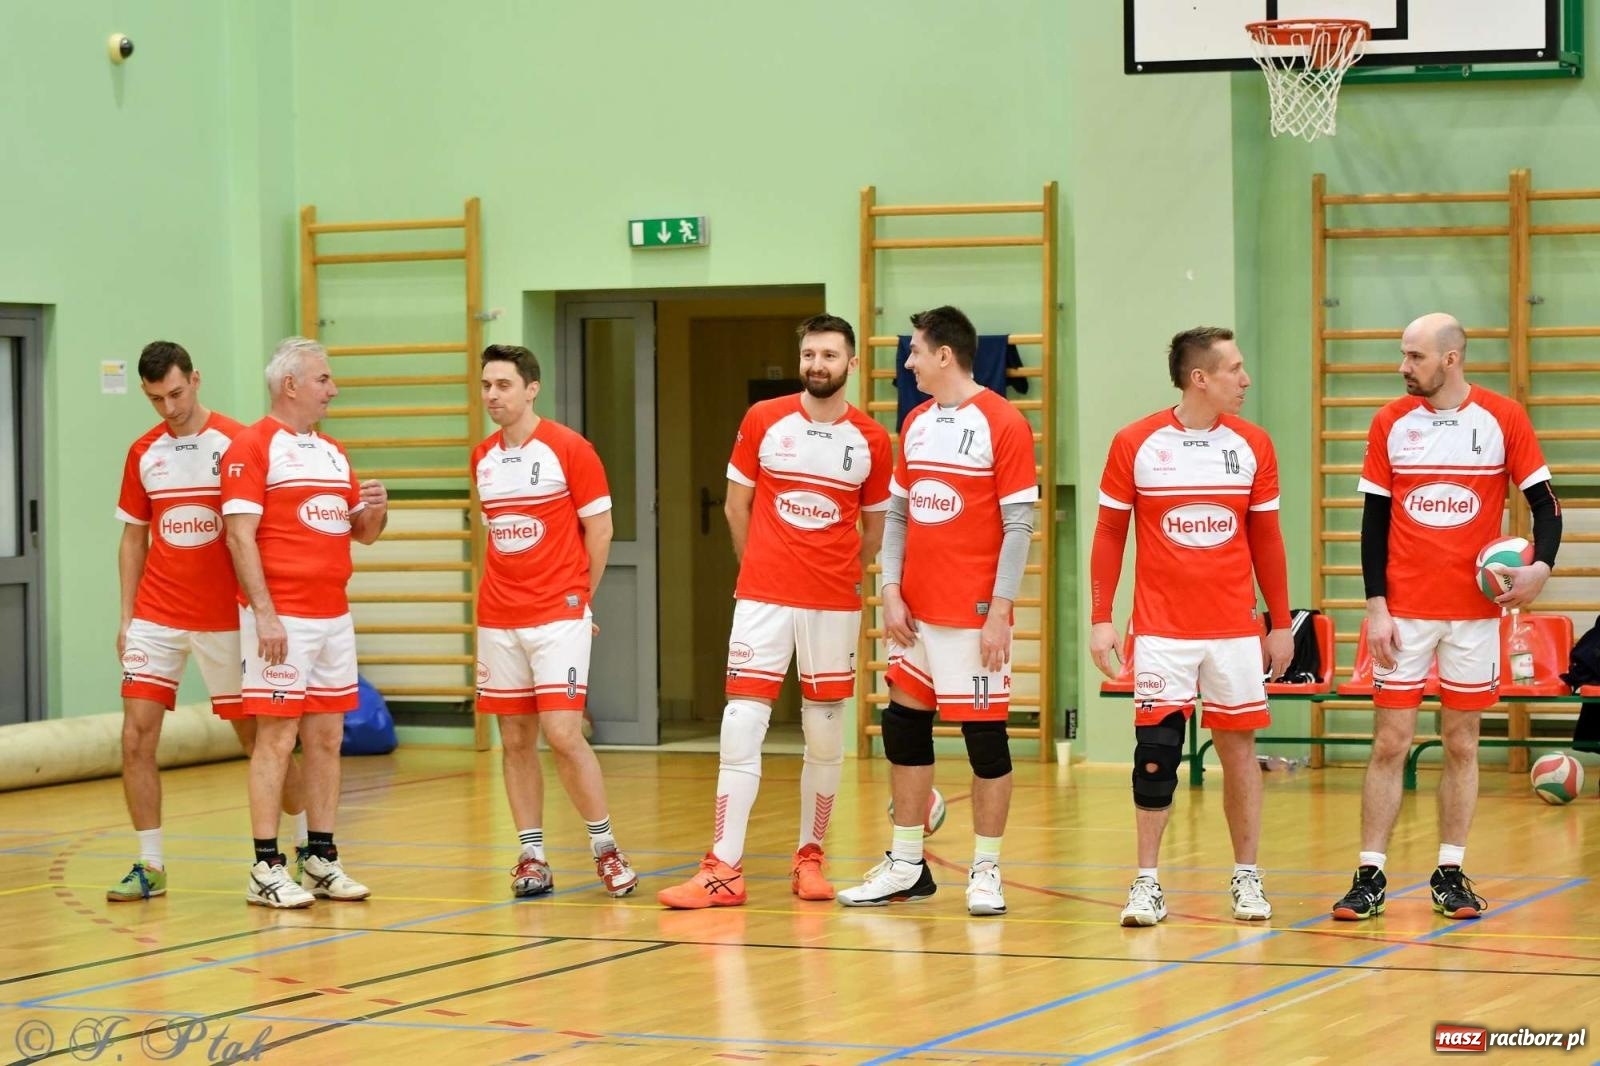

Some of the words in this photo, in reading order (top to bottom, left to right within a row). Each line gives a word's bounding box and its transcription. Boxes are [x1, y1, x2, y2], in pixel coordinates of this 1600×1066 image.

[958, 428, 975, 455] 11
[1472, 429, 1482, 455] 4
[211, 451, 221, 477] 3
[842, 445, 854, 472] 6
[1222, 449, 1240, 475] 10
[530, 461, 540, 486] 9
[778, 498, 837, 520] Henkel
[910, 489, 957, 512] Henkel
[1409, 495, 1474, 514] Henkel
[162, 515, 219, 535] Henkel
[306, 505, 350, 523] Henke
[1167, 515, 1234, 534] Henkel
[731, 648, 751, 658] enkel
[265, 670, 297, 679] Henkel
[567, 667, 577, 699] 9
[972, 676, 989, 709] 11
